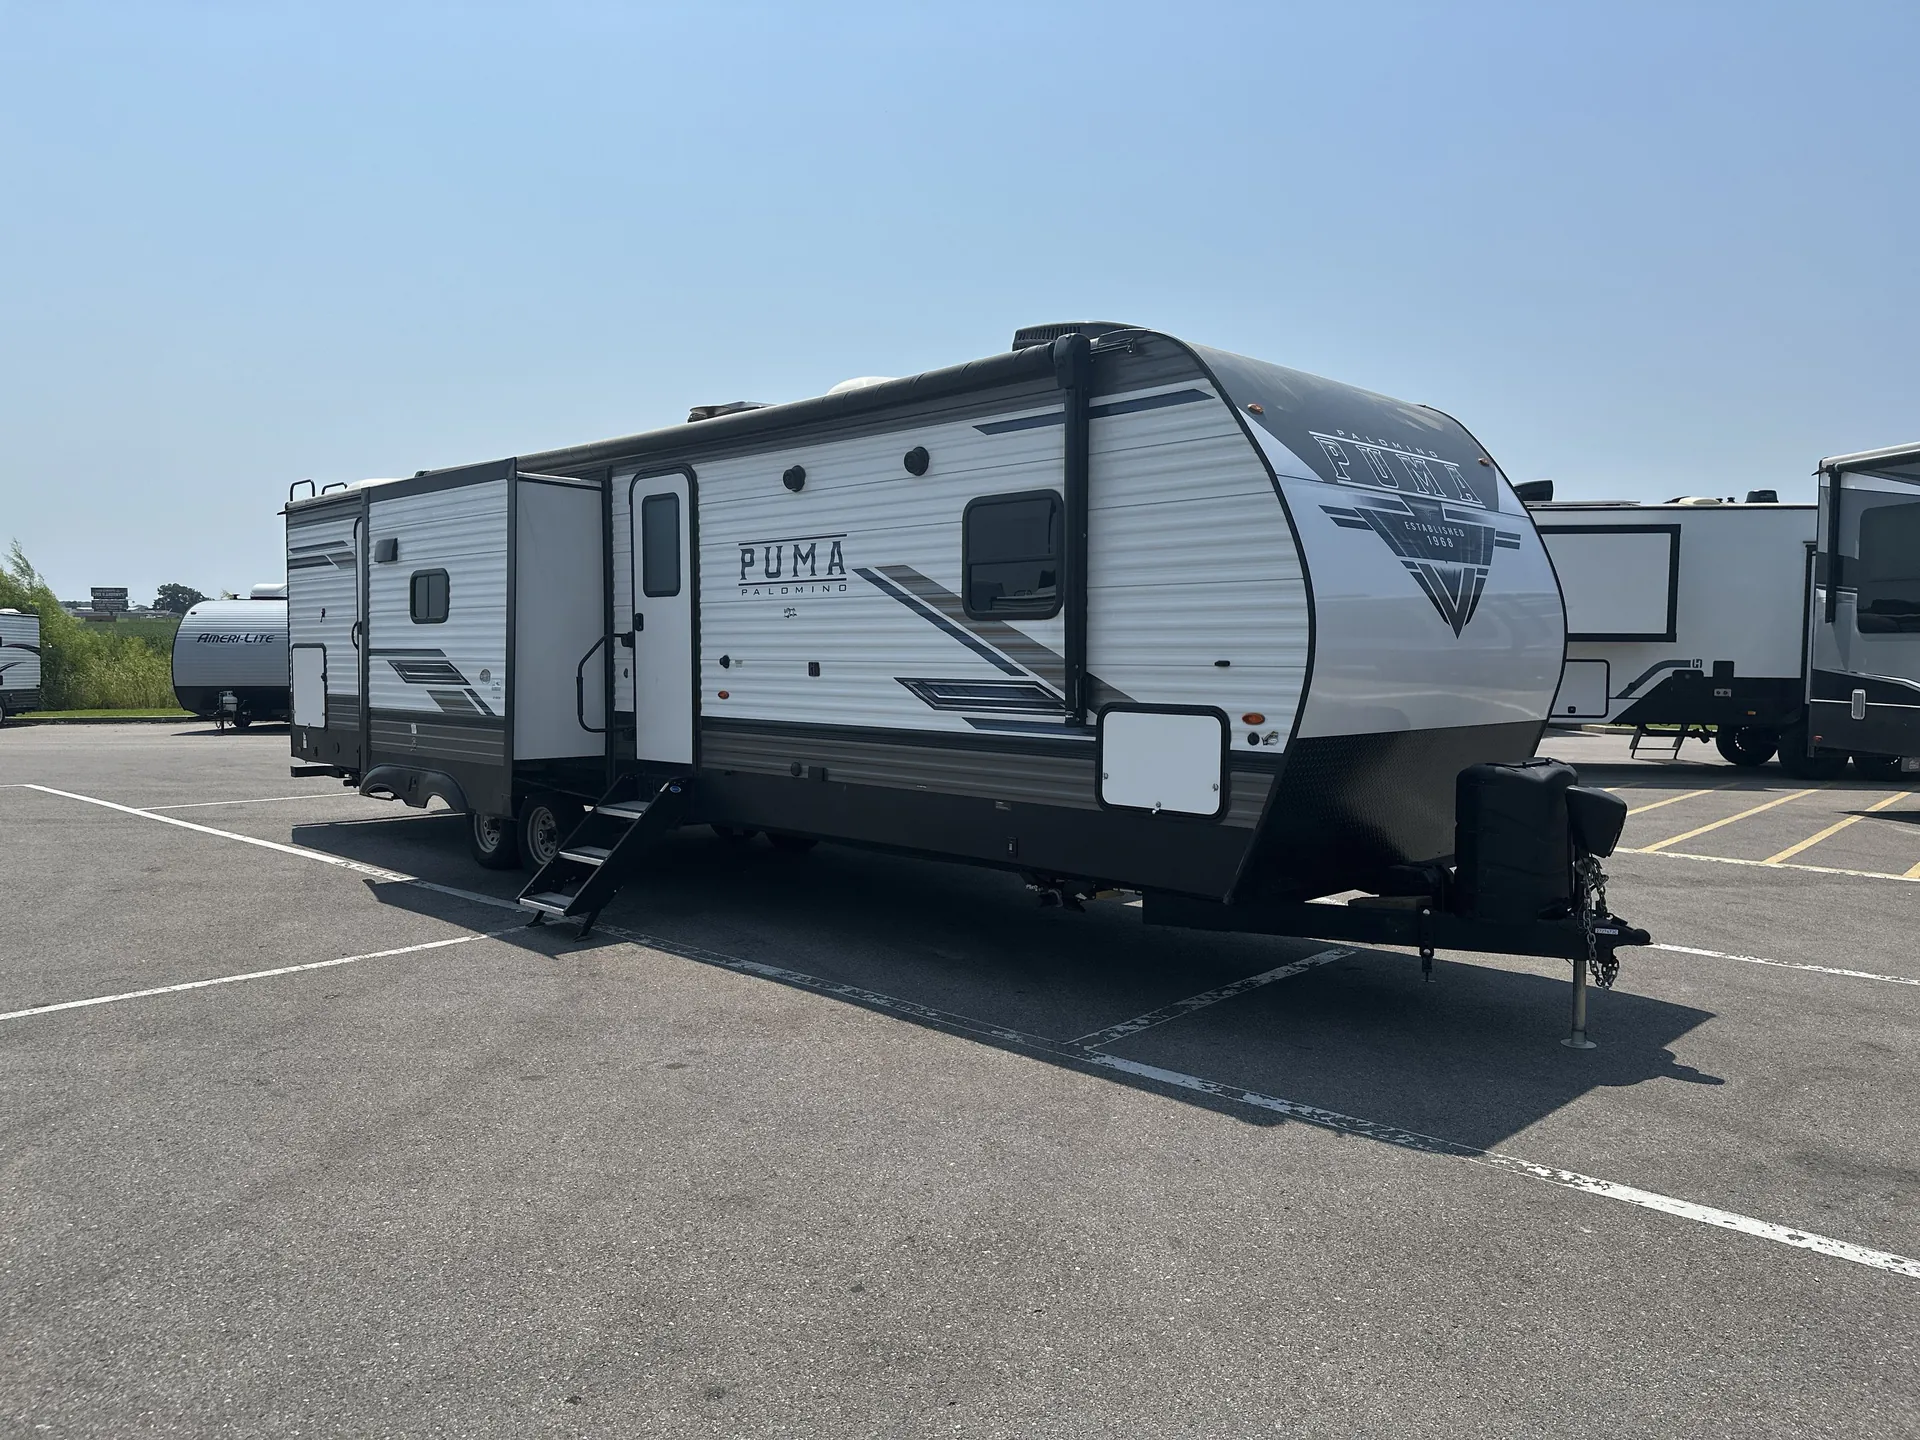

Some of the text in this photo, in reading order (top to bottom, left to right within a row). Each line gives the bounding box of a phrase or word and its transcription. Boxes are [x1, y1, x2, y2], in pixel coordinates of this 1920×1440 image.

[1336, 429, 1438, 458] PALOMINO
[1313, 436, 1483, 504] PUMA
[1404, 521, 1465, 537] ESTABLISHED
[1426, 535, 1454, 548] 1968
[740, 541, 846, 580] PUMA
[741, 584, 847, 596] PALOMINO
